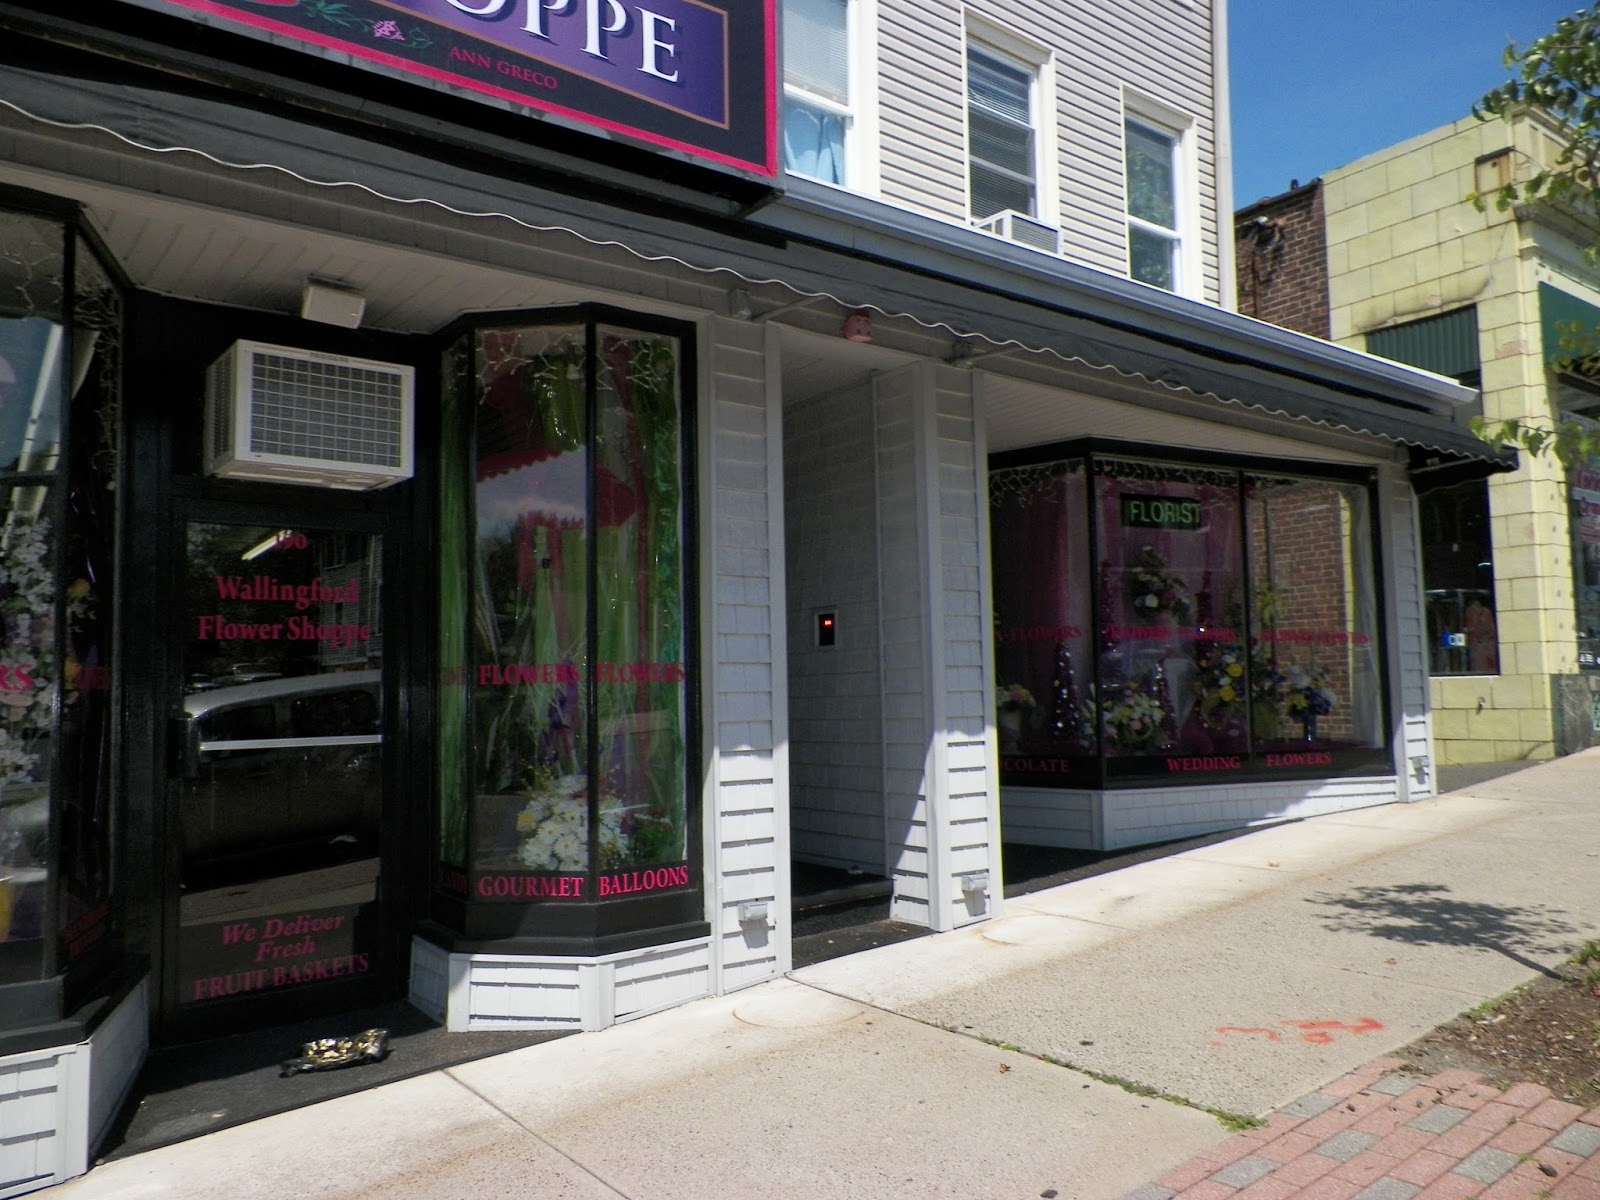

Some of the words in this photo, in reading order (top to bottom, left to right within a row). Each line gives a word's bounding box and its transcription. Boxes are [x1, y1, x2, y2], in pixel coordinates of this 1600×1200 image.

[446, 0, 678, 83] PPE
[449, 46, 491, 69] ANN
[496, 60, 558, 90] GRECO
[1130, 501, 1201, 524] FLORIST
[214, 575, 360, 610] Wallingford
[197, 614, 284, 640] Flower
[286, 615, 372, 649] Shoppe
[478, 663, 580, 686] FLOWERS
[595, 662, 686, 684] FLOWERS
[1001, 758, 1070, 773] COLATE
[1166, 756, 1242, 772] WEDDING
[1266, 752, 1333, 768] FLOWERS
[477, 876, 584, 897] GOURMET
[598, 865, 689, 896] BALLOONS
[221, 923, 256, 945] We
[262, 914, 345, 939] Deliver
[254, 935, 316, 962] Fresh
[192, 969, 269, 1001] FRUIT
[272, 952, 369, 987] BASKETS
